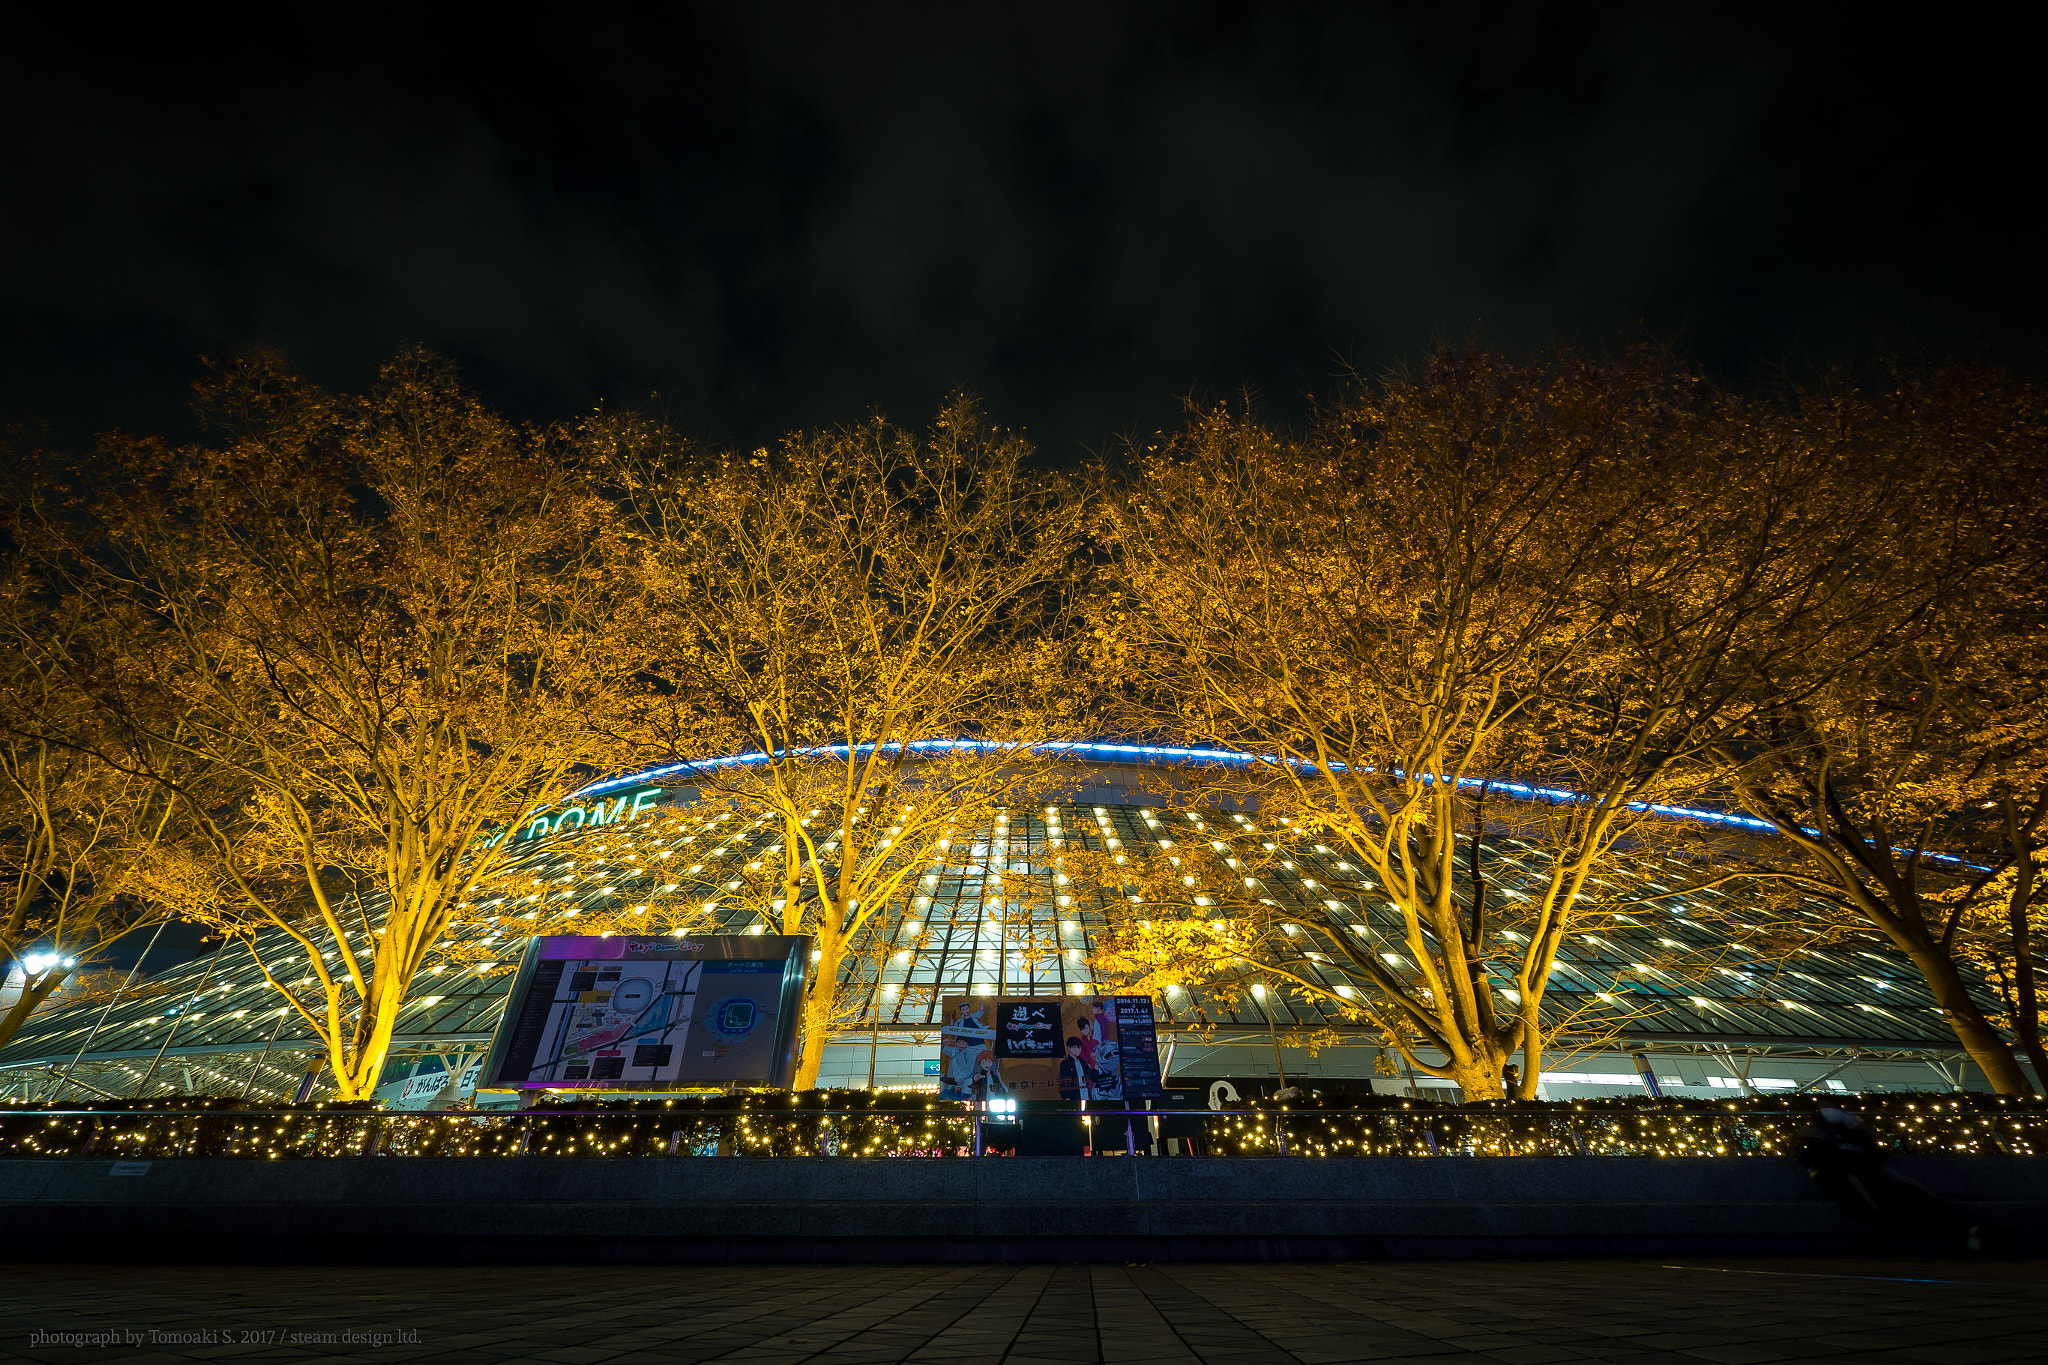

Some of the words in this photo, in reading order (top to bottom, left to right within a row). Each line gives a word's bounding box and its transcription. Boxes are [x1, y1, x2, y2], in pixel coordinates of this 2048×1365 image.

[629, 941, 654, 954] Tokyo
[655, 943, 679, 952] Dome
[679, 941, 704, 952] City
[1011, 1006, 1046, 1021] 遊べ
